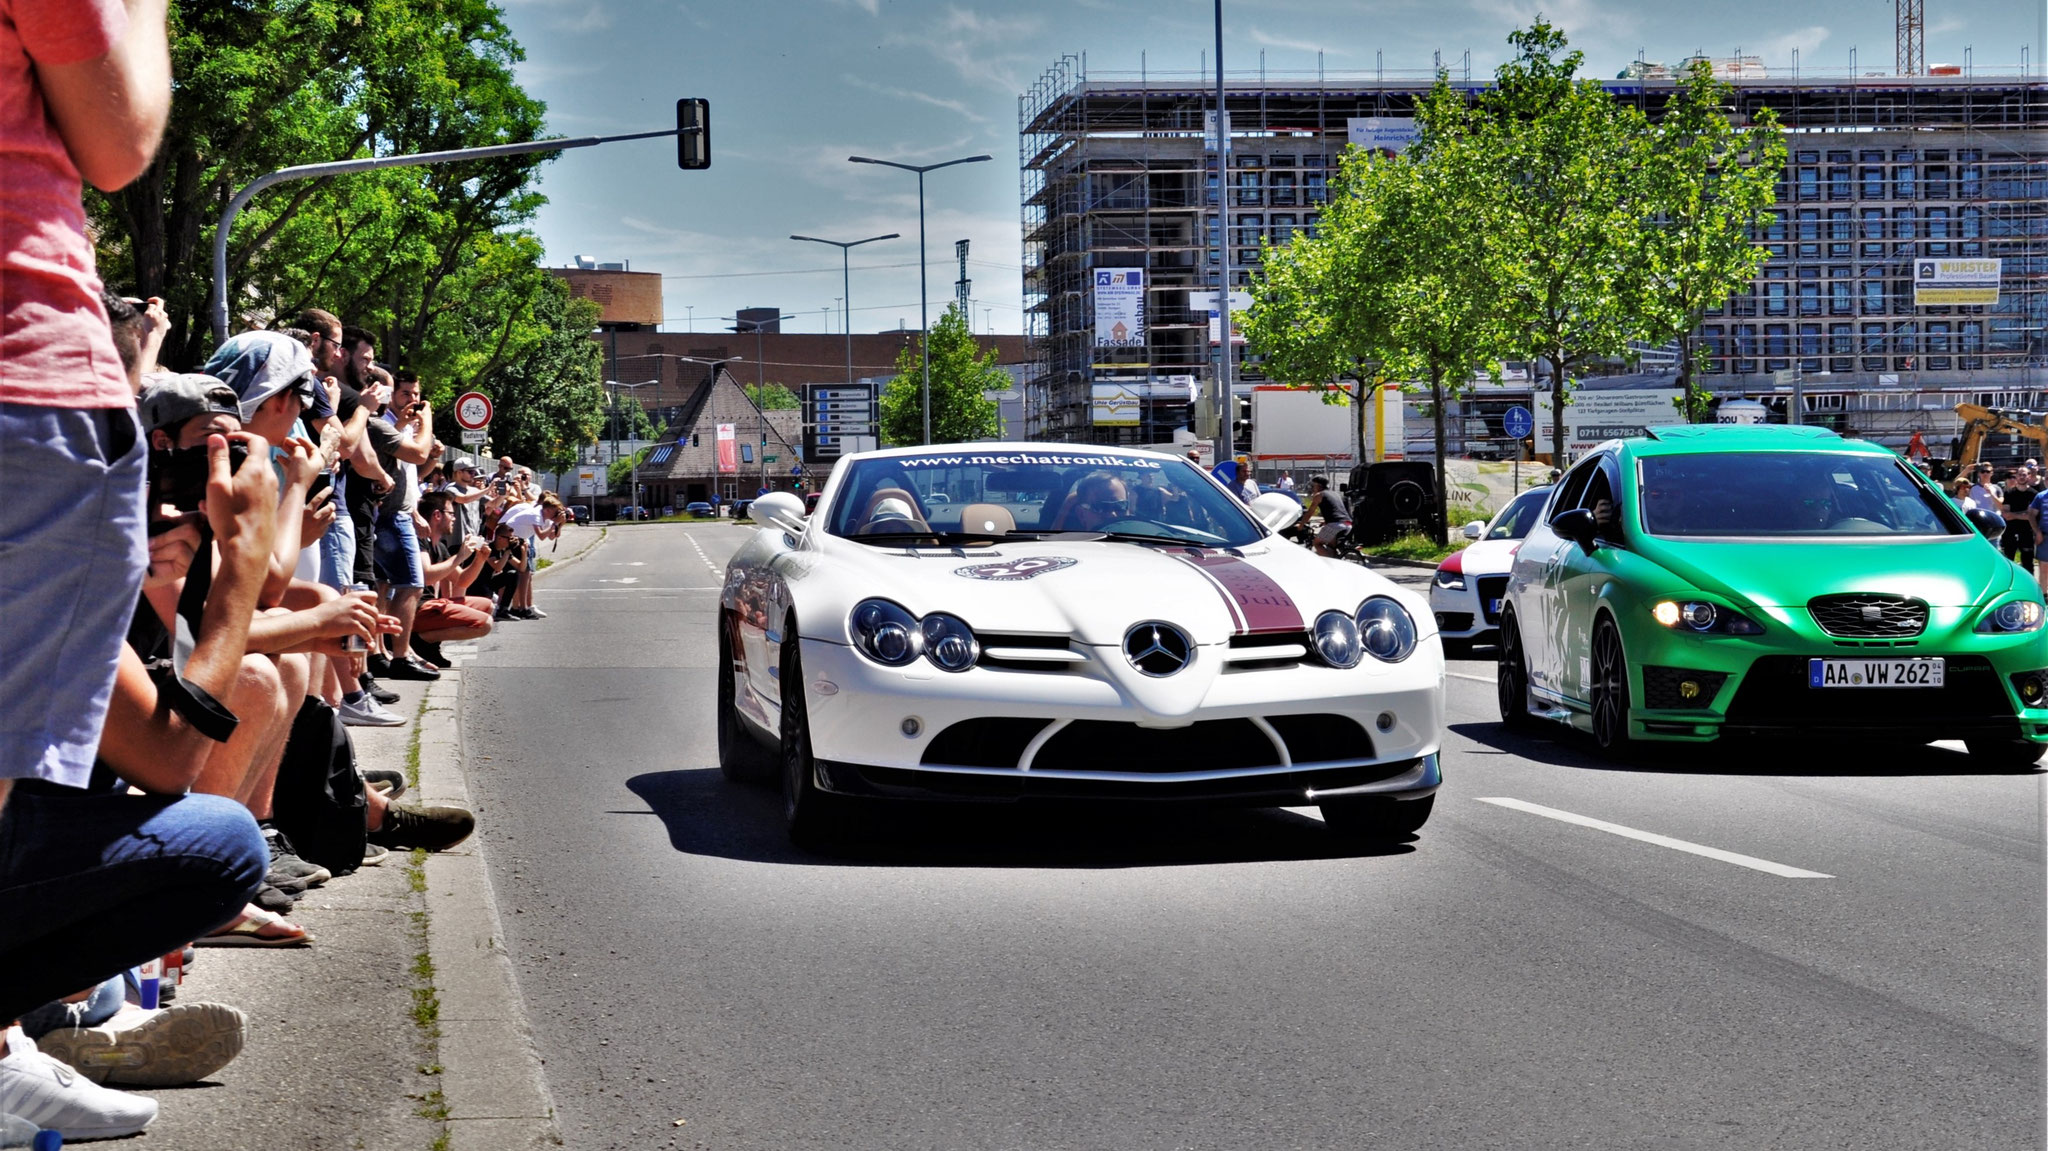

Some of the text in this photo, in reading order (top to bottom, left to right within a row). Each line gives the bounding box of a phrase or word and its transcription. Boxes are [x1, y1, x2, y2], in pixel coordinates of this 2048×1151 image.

[1939, 262, 1998, 272] WURSTER
[1134, 297, 1145, 337] Ausbau
[1097, 336, 1142, 347] Fassade
[1579, 428, 1645, 437] 0711 656782-0
[898, 454, 1161, 470] www.mechatronik.de
[979, 560, 1049, 576] 20
[1238, 594, 1291, 607] Juli
[1824, 663, 1930, 684] AA VW 262
[1932, 676, 1942, 684] 10
[141, 964, 153, 975] ull
